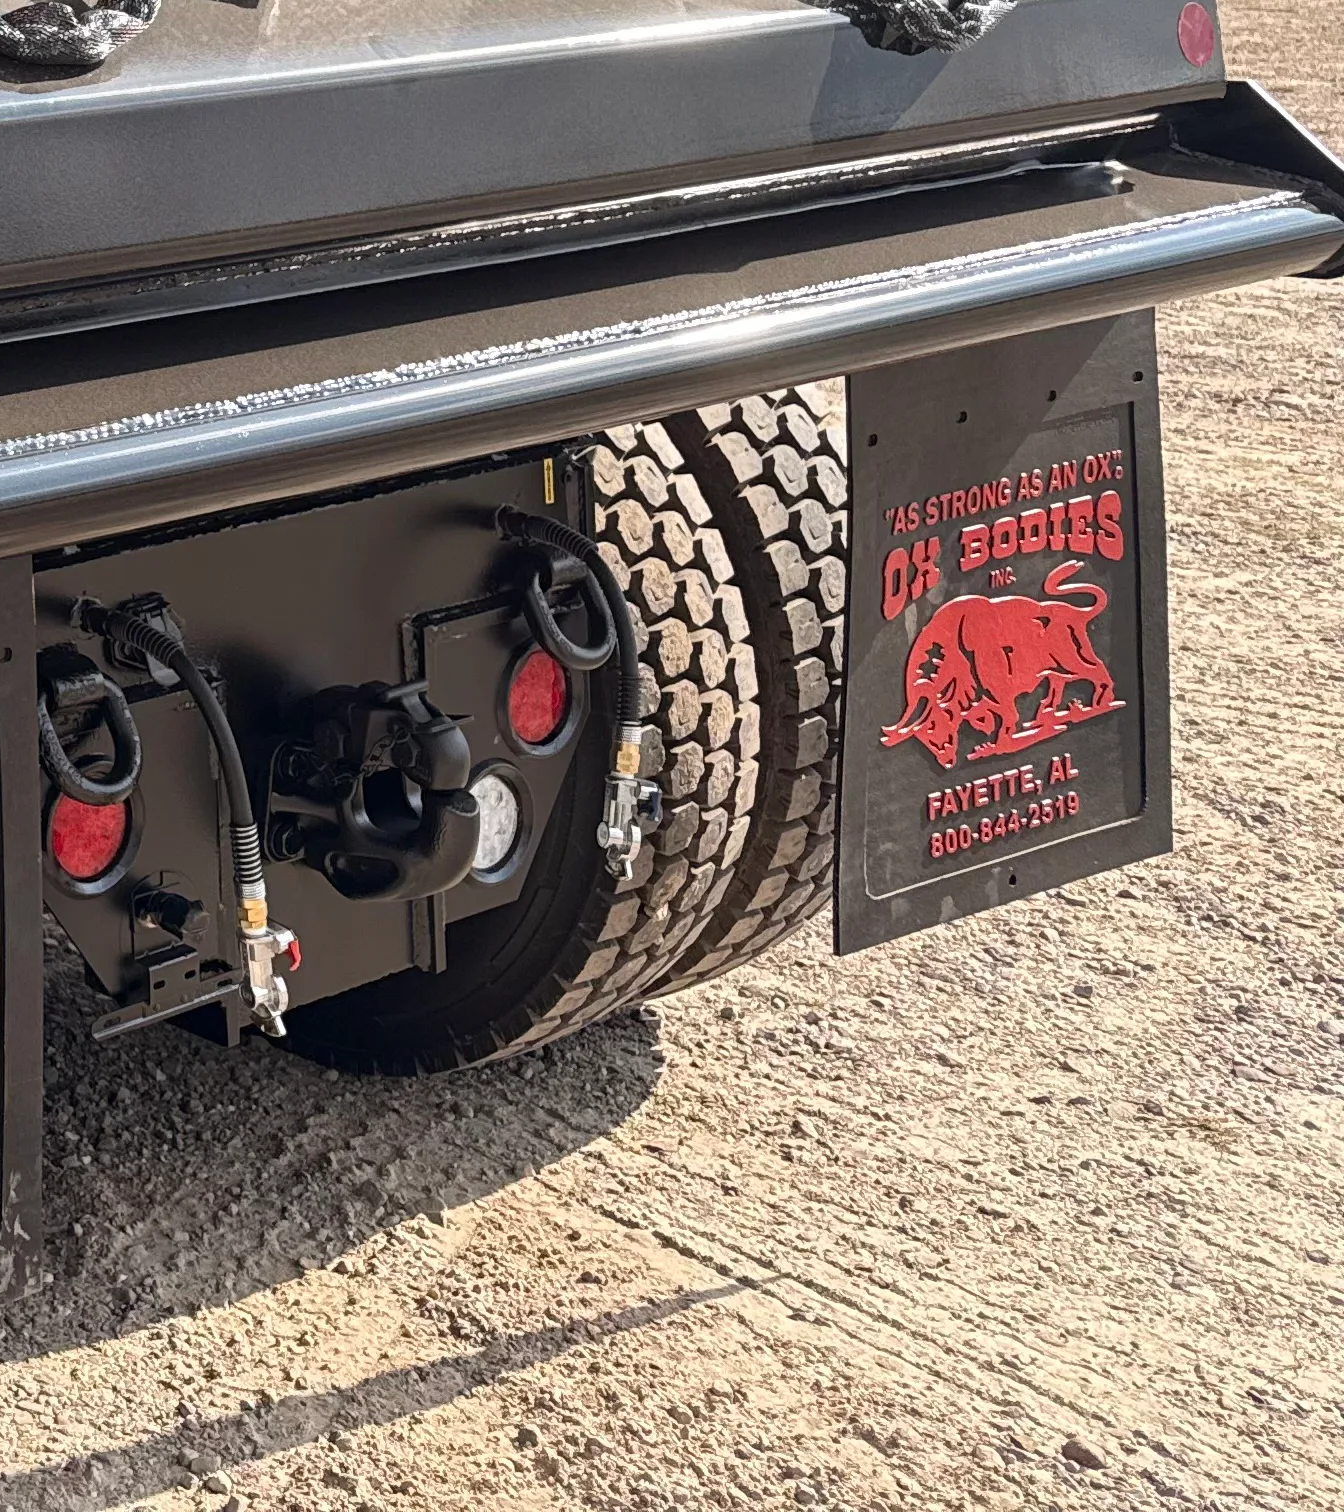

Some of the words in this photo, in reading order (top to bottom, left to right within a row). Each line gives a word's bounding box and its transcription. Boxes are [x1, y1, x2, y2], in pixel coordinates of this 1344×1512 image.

[924, 477, 1012, 527] STRONG
[1016, 468, 1044, 502] AS
[1048, 458, 1077, 494] AN
[881, 536, 942, 621] OX
[959, 490, 1125, 572] BODIES
[927, 764, 1044, 822] FAYETTE,
[1049, 752, 1080, 785] AL
[930, 791, 1080, 859] 800-844-2519
